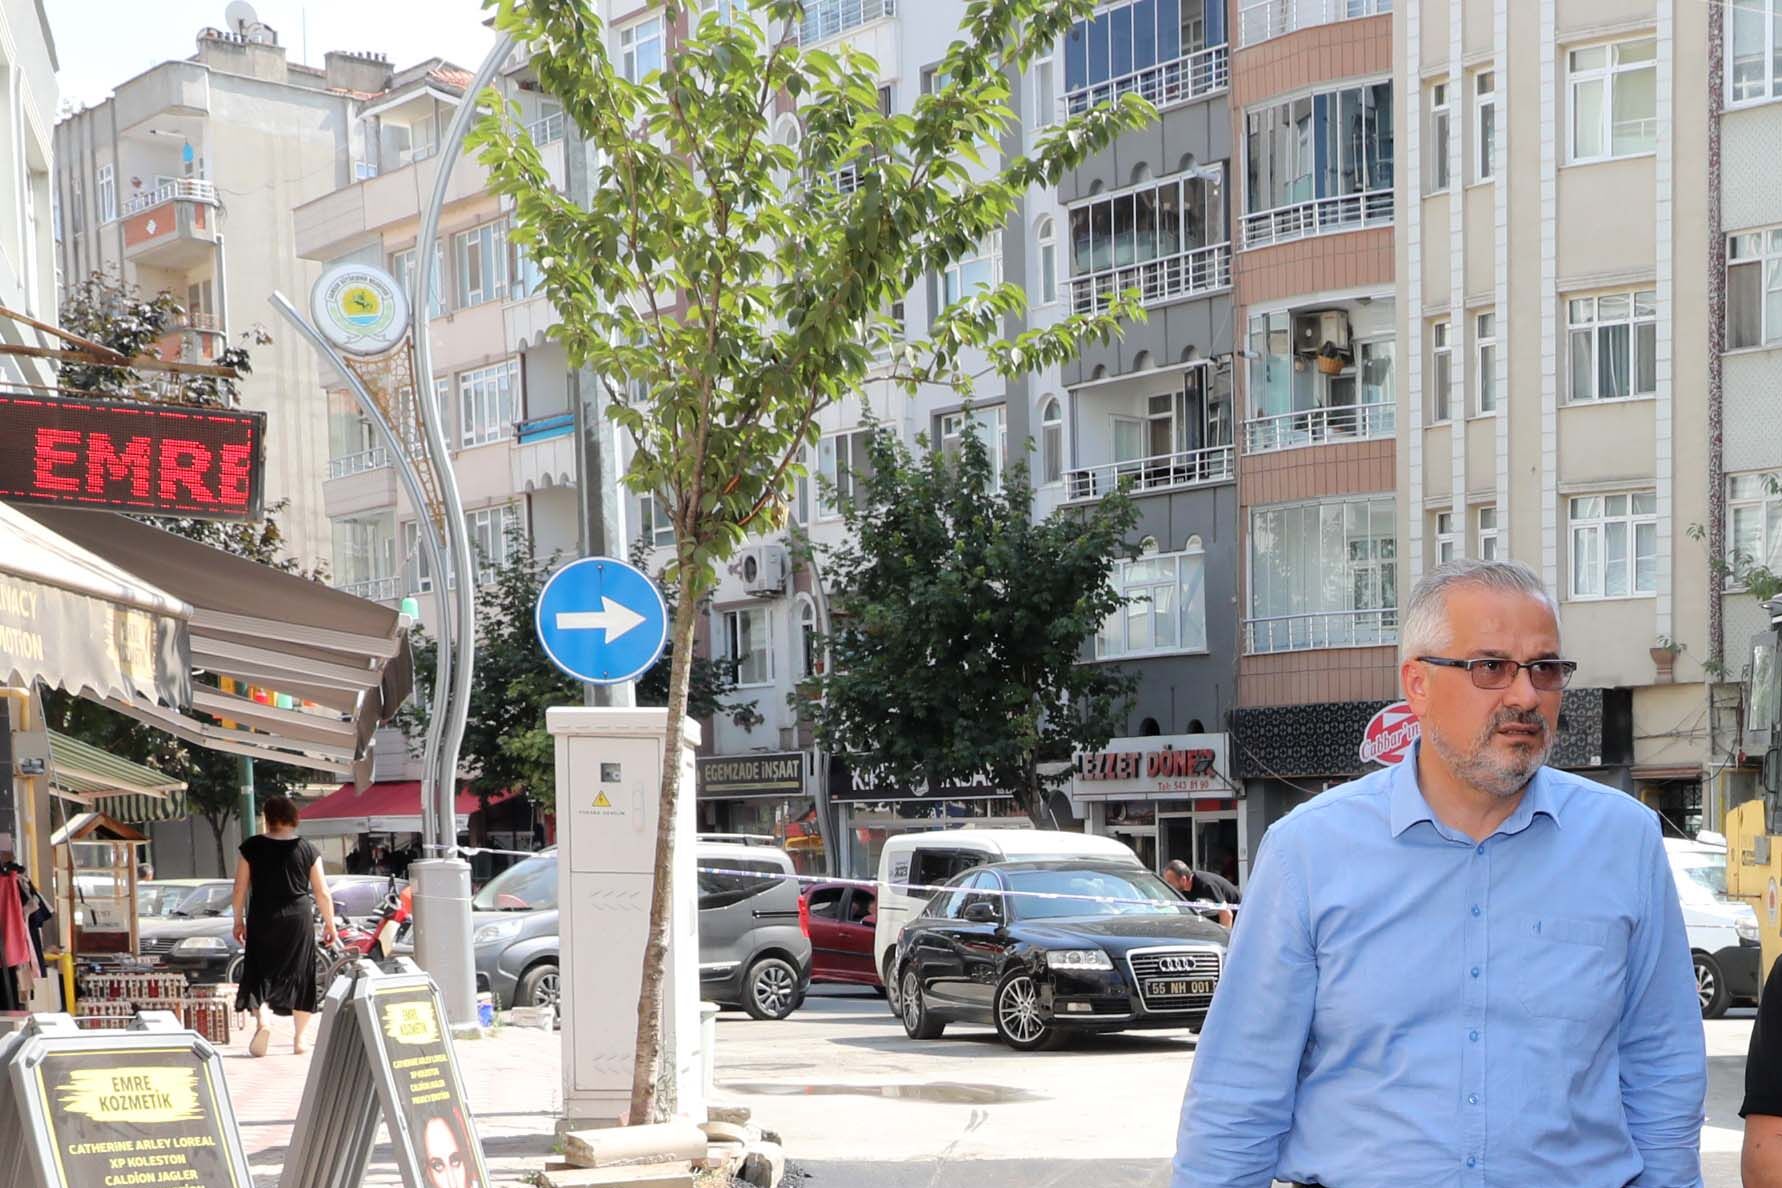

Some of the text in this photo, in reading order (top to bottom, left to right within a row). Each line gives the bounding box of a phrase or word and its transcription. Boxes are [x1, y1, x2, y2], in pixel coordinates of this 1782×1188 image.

[704, 763, 760, 781] EGEMZADE
[1152, 981, 1210, 994] 55 NH 001
[111, 1075, 153, 1092] EMRE
[99, 1089, 173, 1112] KOZMETİK
[135, 1138, 171, 1150] ARLEY
[174, 1136, 216, 1147] LOREAL
[109, 1154, 186, 1169] XP KOLESTON
[104, 1169, 198, 1186] CALDİON JAGLER
